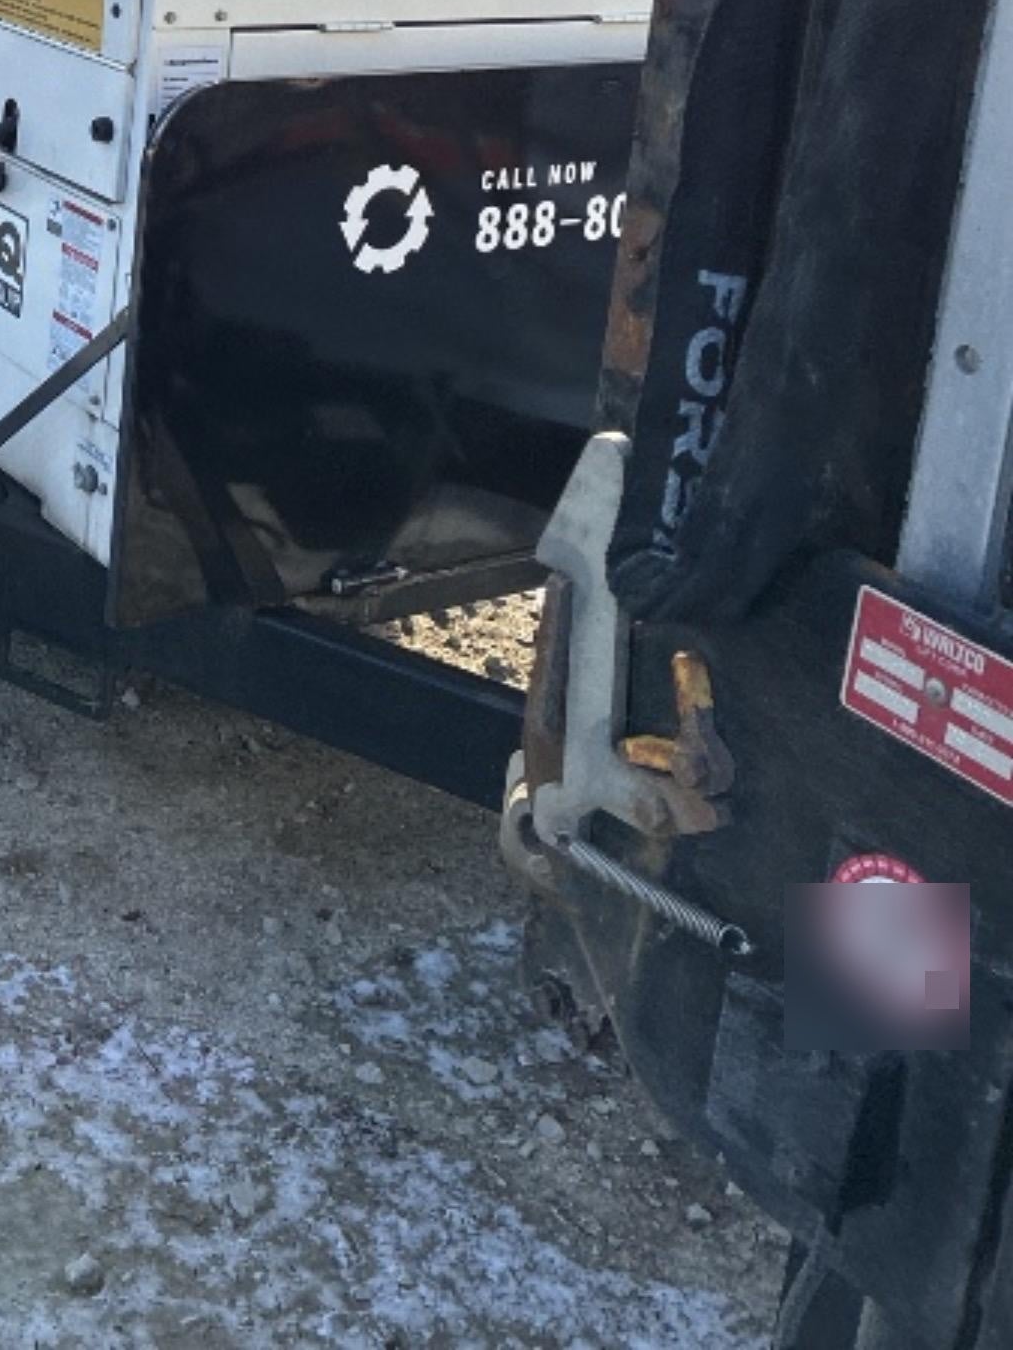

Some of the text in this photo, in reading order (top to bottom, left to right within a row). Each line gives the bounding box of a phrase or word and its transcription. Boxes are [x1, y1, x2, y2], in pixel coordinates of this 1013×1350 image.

[481, 161, 597, 191] CALL NOW
[921, 625, 985, 676] WALTCO
